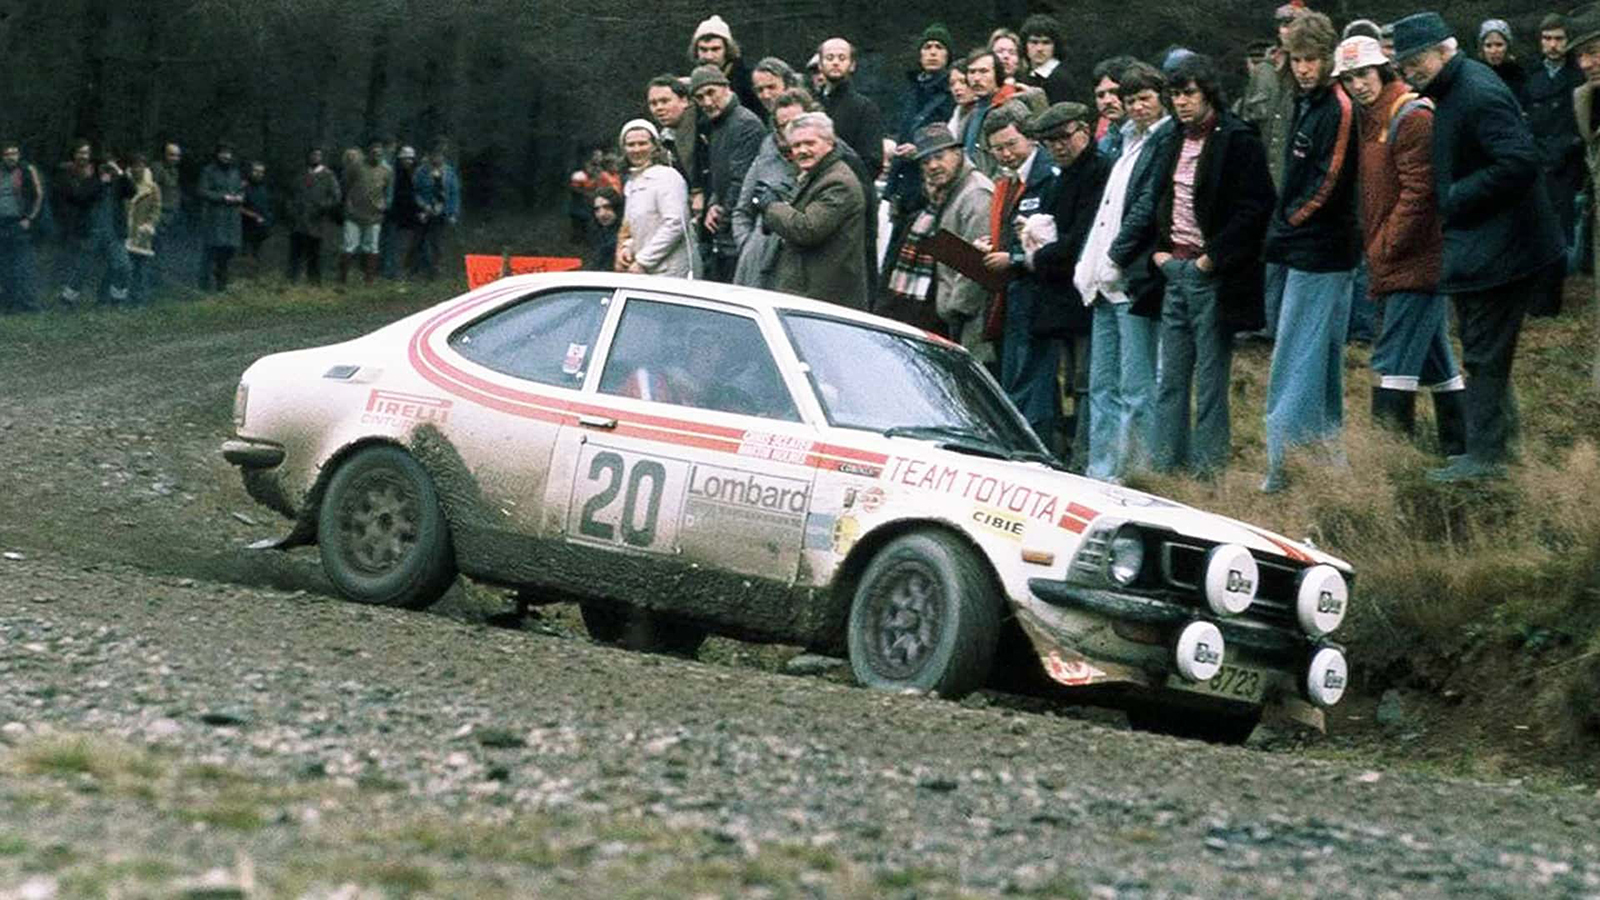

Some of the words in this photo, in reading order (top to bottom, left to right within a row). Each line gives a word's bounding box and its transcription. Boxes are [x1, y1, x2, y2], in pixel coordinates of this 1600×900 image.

[366, 389, 453, 423] PIRELLI
[579, 451, 666, 548] 20
[688, 465, 811, 512] Lombard
[889, 456, 959, 492] TEAM
[963, 472, 1059, 524] TOYOTA
[972, 511, 1025, 536] CIBIE
